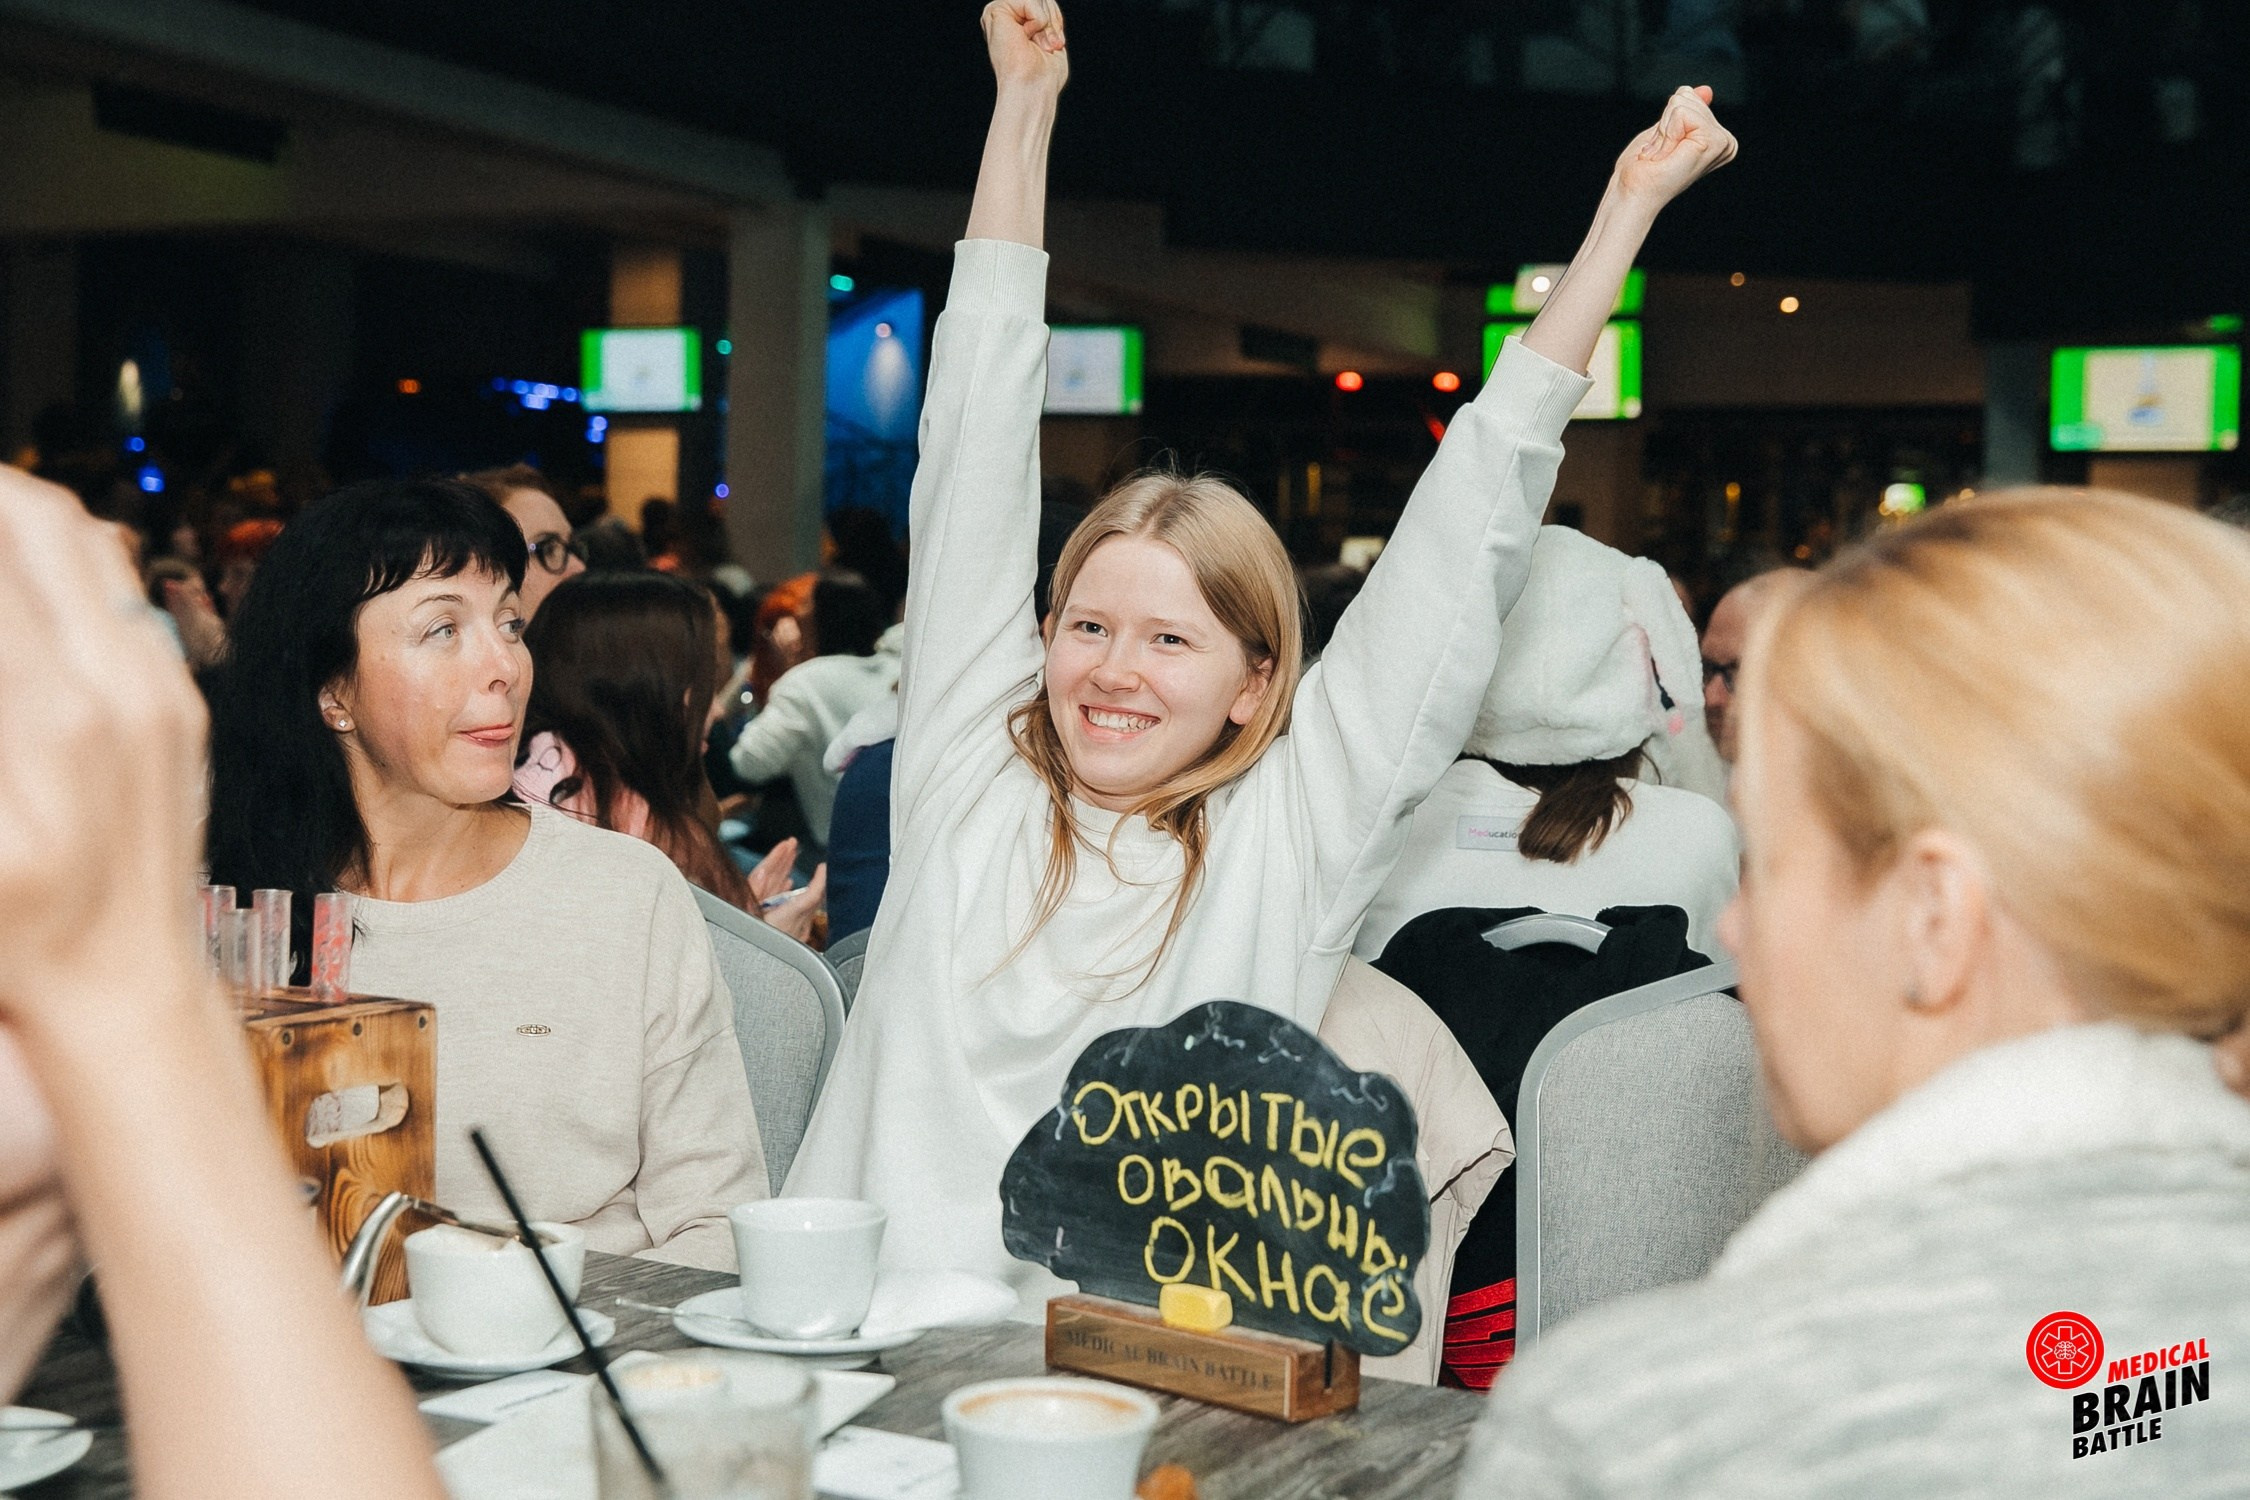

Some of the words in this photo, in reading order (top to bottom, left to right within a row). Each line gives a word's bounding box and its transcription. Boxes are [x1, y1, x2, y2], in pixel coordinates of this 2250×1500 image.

[1468, 827, 1518, 839] Meducatio
[1065, 1330, 1140, 1361] MEDICAL
[1146, 1347, 1199, 1375] BRAIN
[1205, 1358, 1272, 1390] BATTLE
